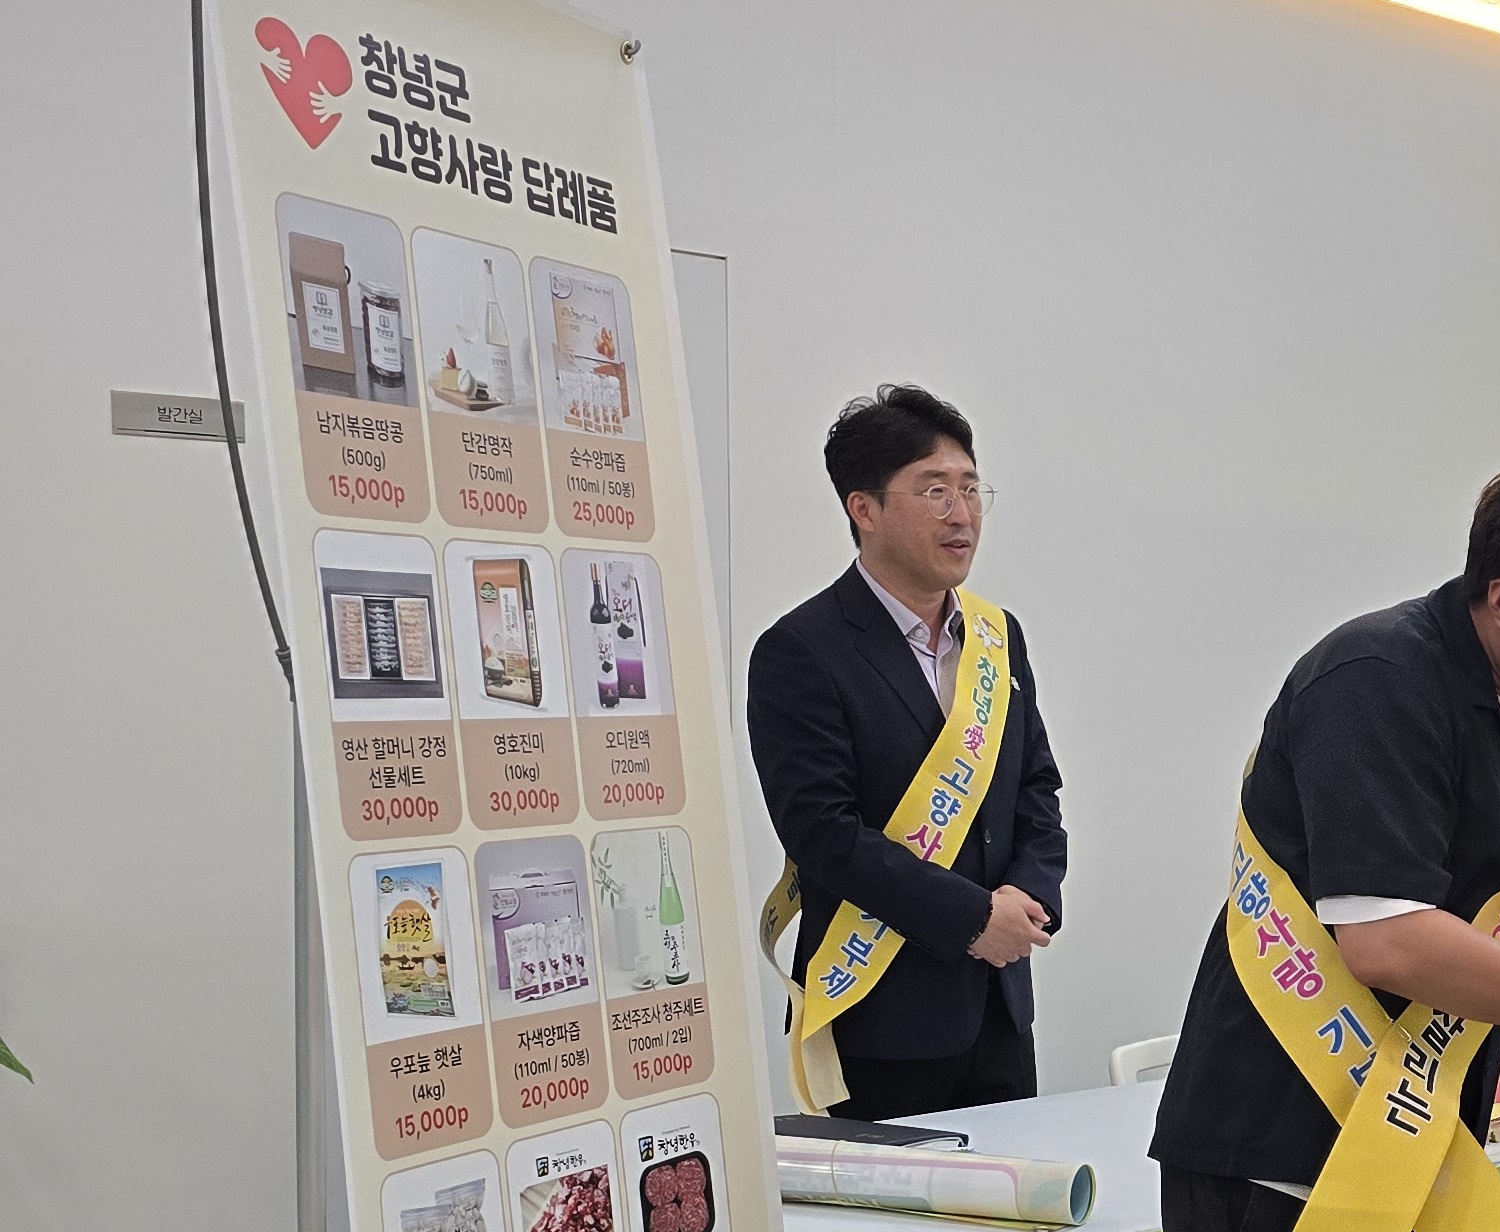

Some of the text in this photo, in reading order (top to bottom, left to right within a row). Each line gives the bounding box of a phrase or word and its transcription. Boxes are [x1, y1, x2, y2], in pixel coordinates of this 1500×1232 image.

[359, 33, 471, 123] 창녕군
[367, 109, 619, 235] 고향사랑 답례품
[157, 405, 203, 426] 발간실
[316, 410, 404, 444] 남지볶음땅콩
[461, 430, 513, 458] 단감명작
[341, 447, 387, 471] (500g)
[569, 447, 626, 473] 순수양파즙
[468, 462, 513, 485] (750ml)
[566, 475, 600, 496] (110ml
[328, 474, 405, 508] 15,000p
[459, 487, 527, 519] 15,000p
[572, 501, 634, 529] 25,000p
[961, 655, 998, 760] 창녕愛
[341, 734, 447, 762] 영산 할머니 강정
[493, 732, 544, 755] 영호진미
[605, 729, 650, 750] 오디원액
[368, 765, 425, 790] 선물세트
[503, 763, 540, 783] (10kg)
[610, 757, 650, 777] (720ml)
[489, 788, 560, 816] 30,000p
[602, 782, 665, 806] 20,000p
[361, 797, 439, 826] 30,000p
[1231, 840, 1324, 999] 고향사랑
[611, 996, 705, 1032] 조선주조사 청주세트
[517, 1020, 580, 1052] 자색양파즙
[628, 1034, 663, 1055] (700ml
[671, 1025, 692, 1047] 2입)
[389, 1043, 463, 1080] 우포늪 햇살
[513, 1060, 552, 1082] (110ml
[561, 1048, 590, 1072] 50봉)
[632, 1051, 692, 1083] 15,000p
[411, 1079, 446, 1103] (4kg)
[520, 1076, 589, 1110] 20,000p
[395, 1104, 469, 1140] 15,000p
[657, 1132, 697, 1156] 창녕한우
